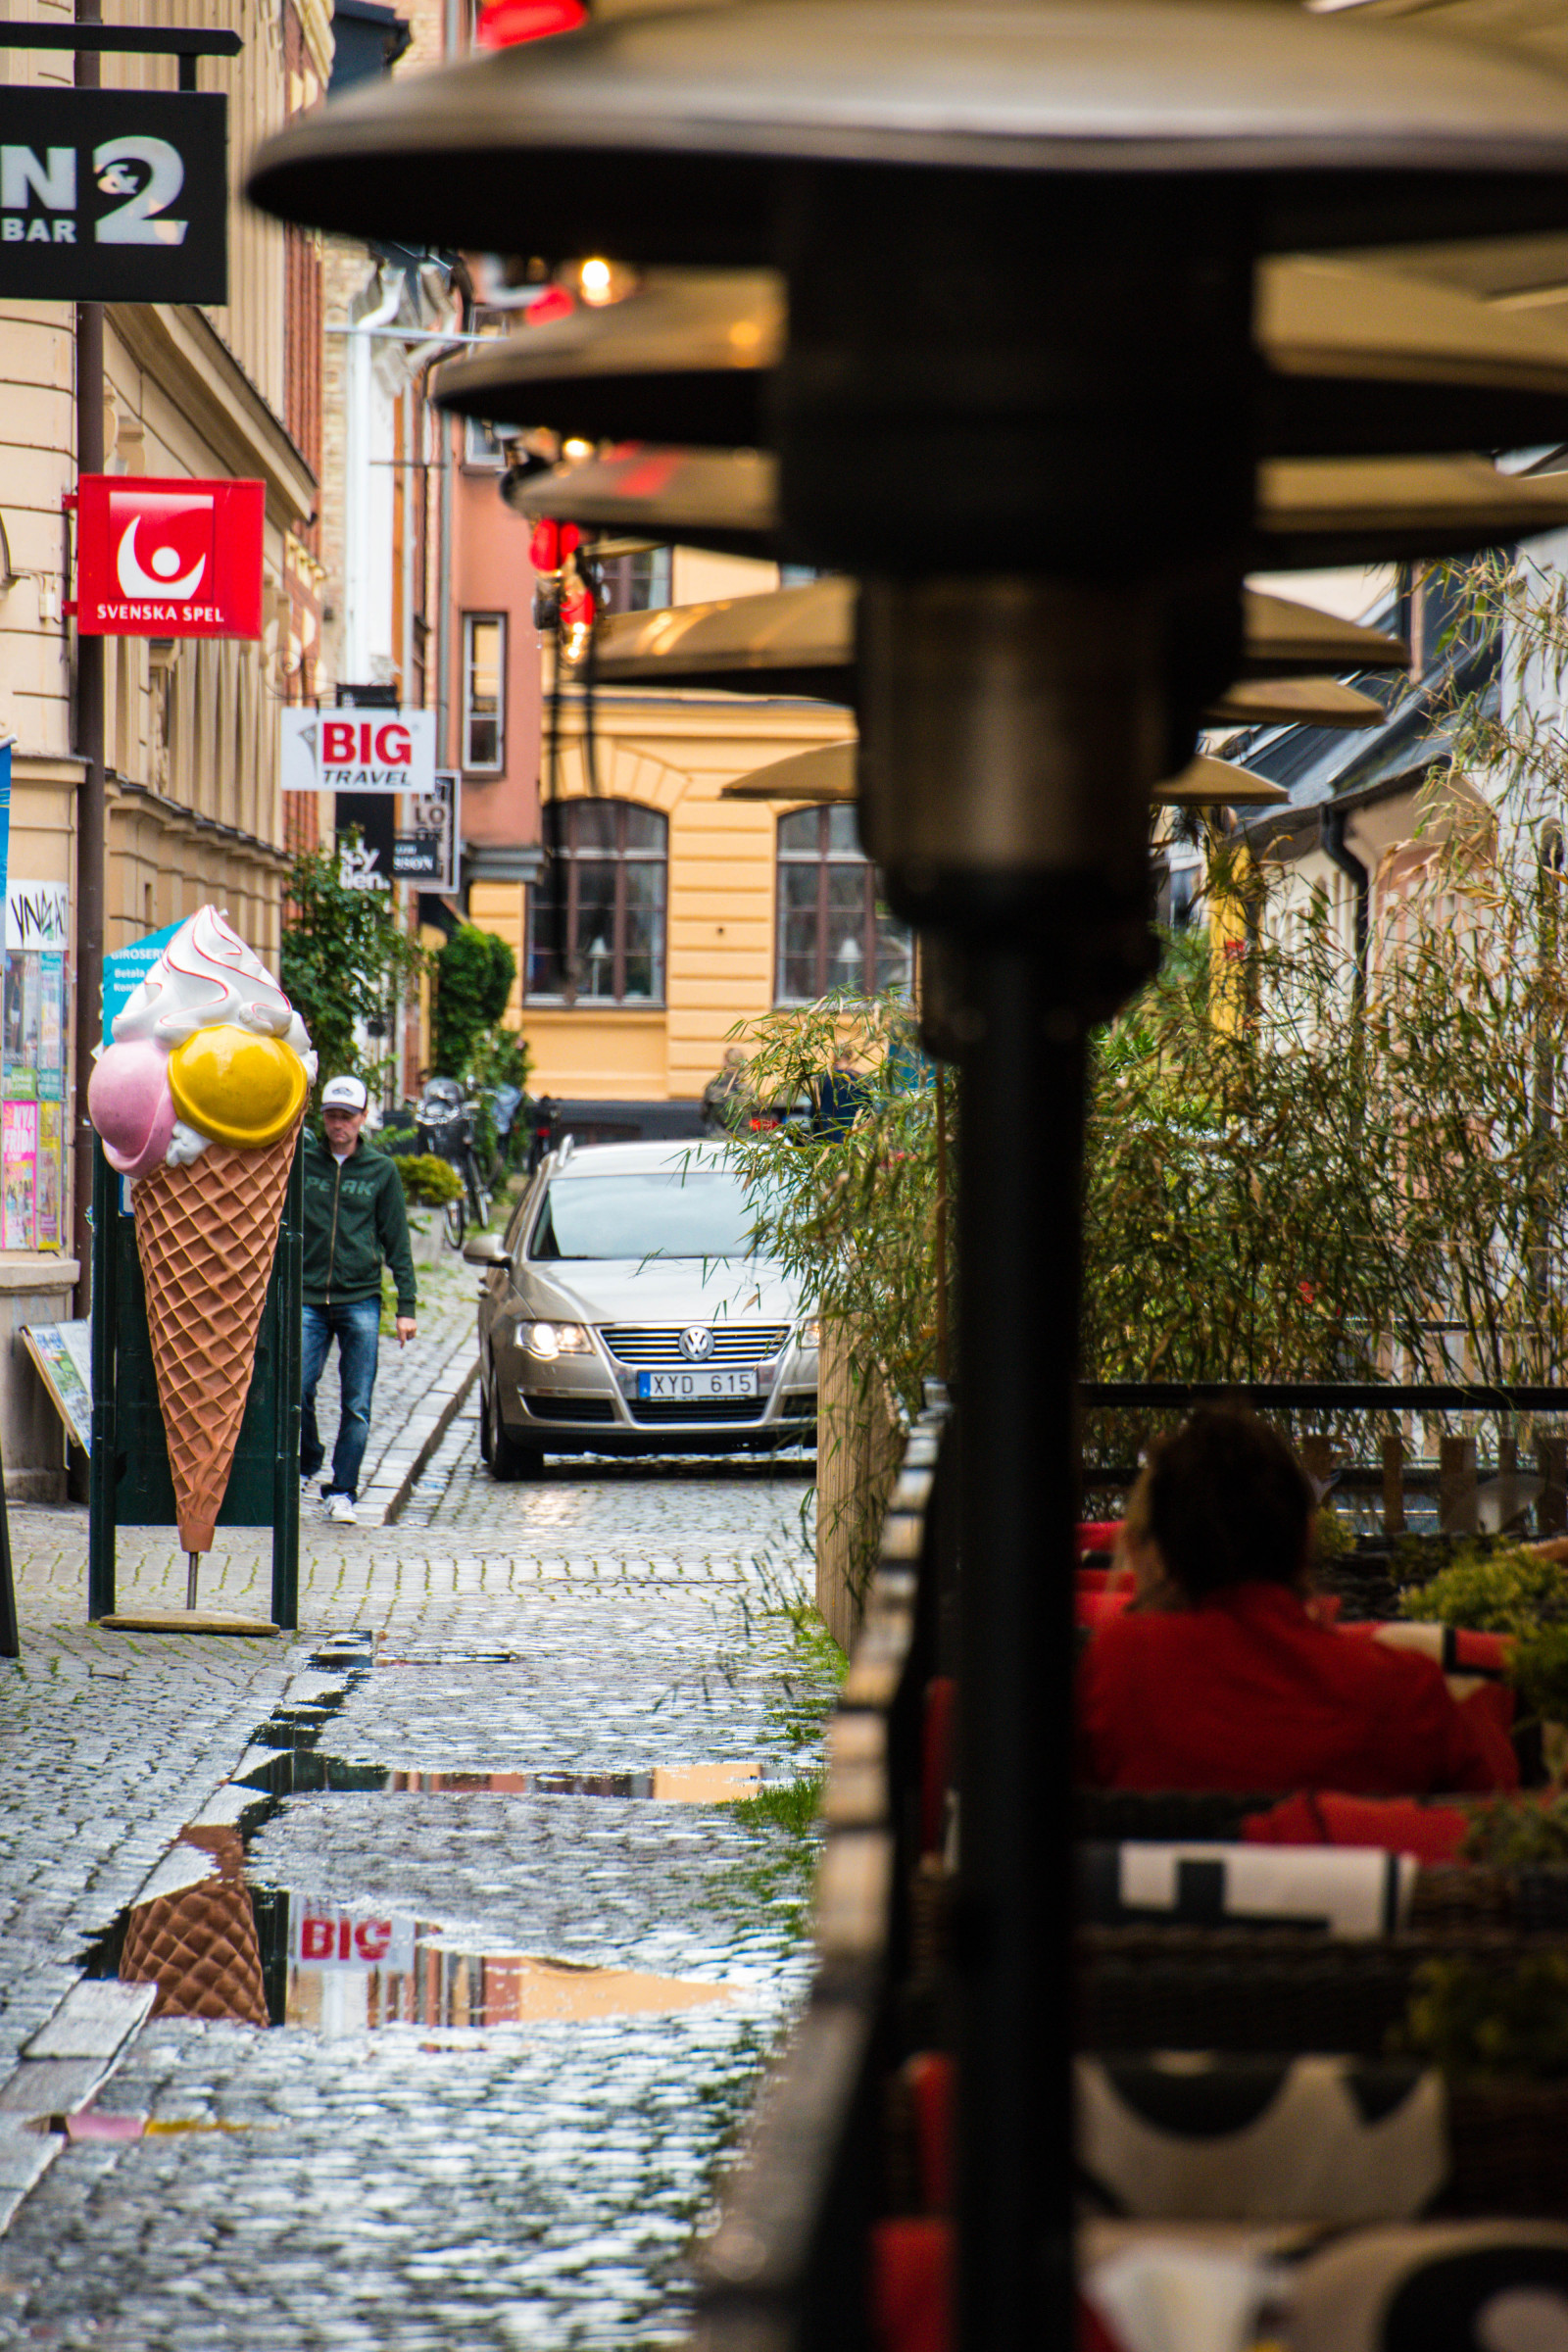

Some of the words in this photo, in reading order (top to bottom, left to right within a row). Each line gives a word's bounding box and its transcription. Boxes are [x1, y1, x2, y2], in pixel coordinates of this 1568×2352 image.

[1, 218, 76, 243] BAR
[97, 604, 177, 620] SVENSKA
[182, 607, 224, 621] SPEL
[322, 722, 412, 766] BIG
[323, 770, 412, 786] TRAVEL
[655, 1376, 693, 1394] XYD
[710, 1375, 752, 1393] 615
